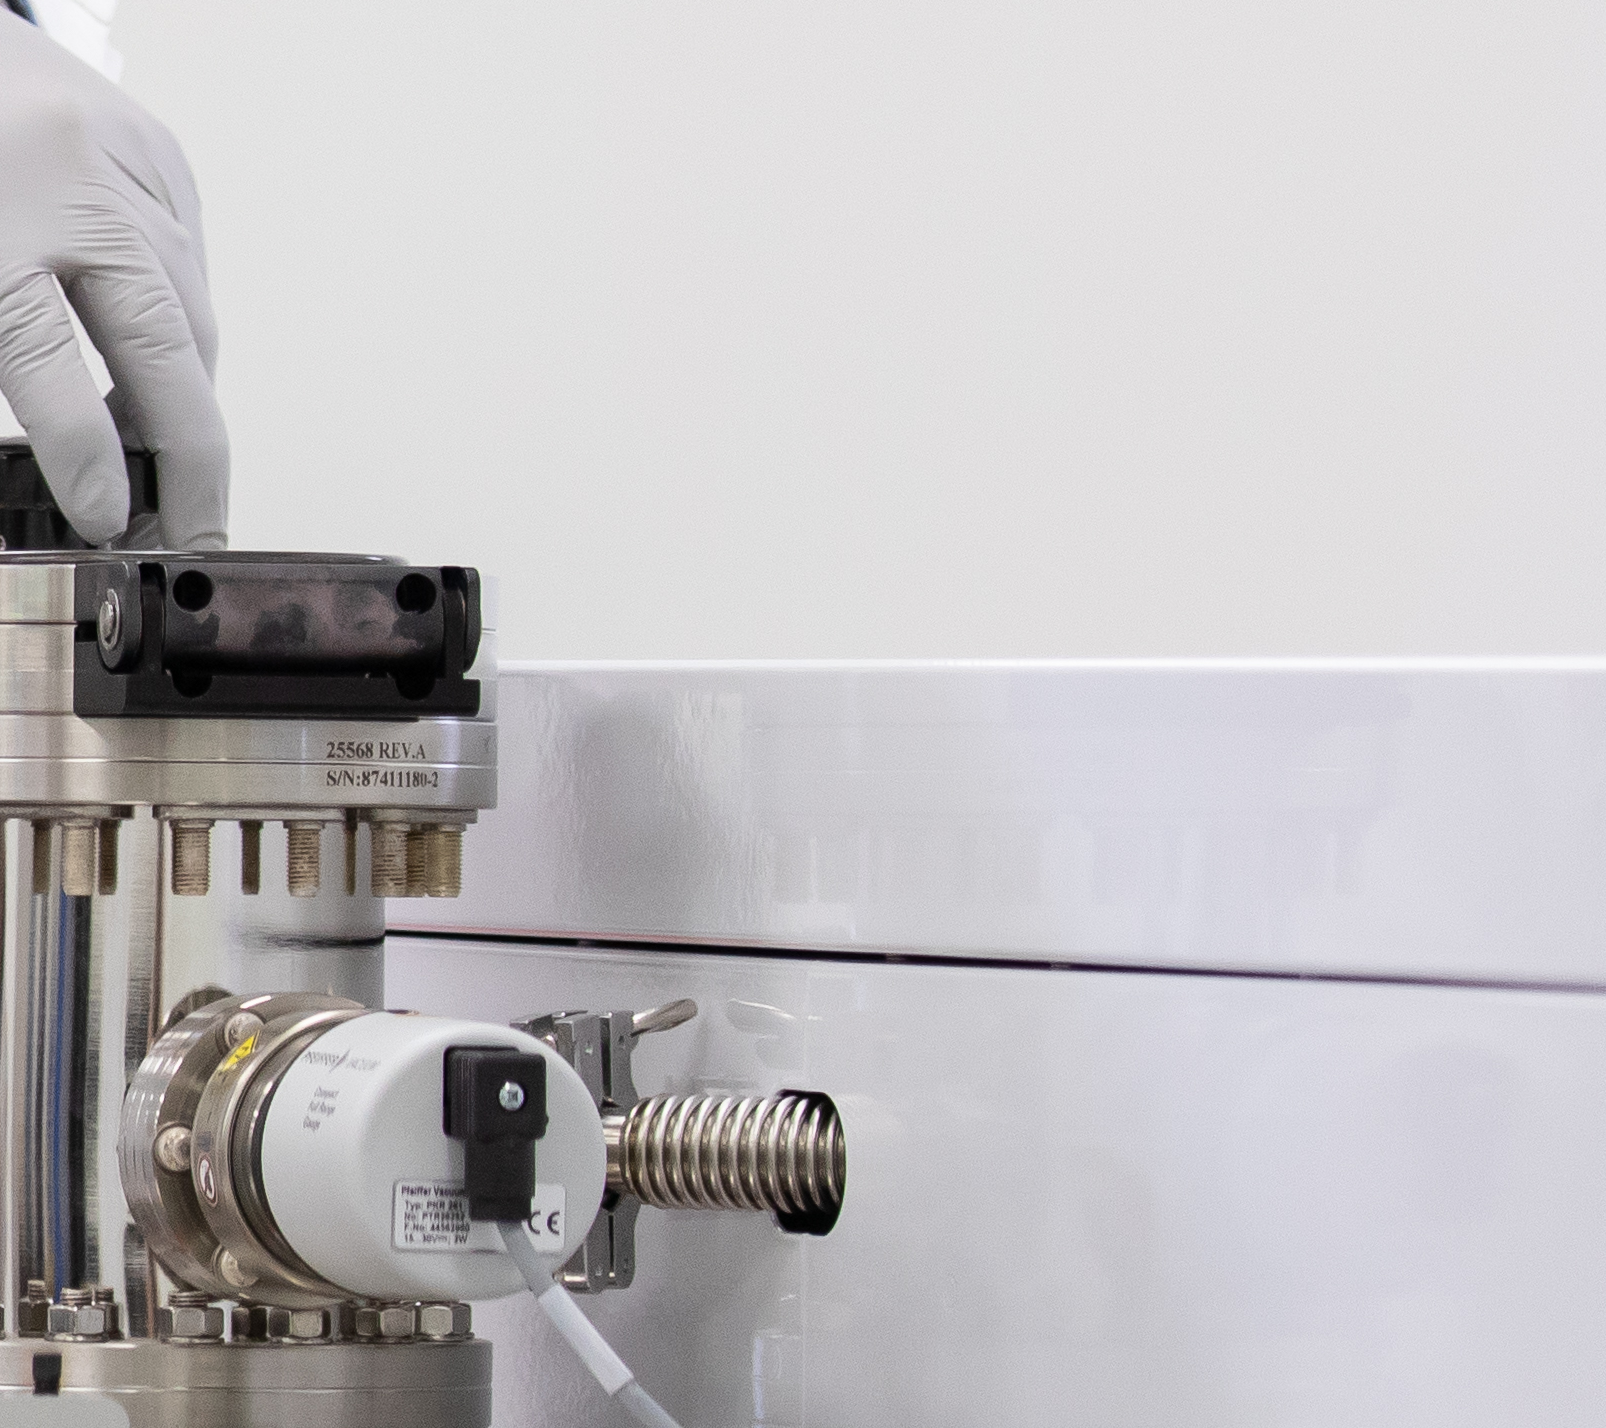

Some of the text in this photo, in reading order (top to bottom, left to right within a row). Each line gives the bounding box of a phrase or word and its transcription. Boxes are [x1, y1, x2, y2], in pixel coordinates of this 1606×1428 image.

[326, 741, 426, 759] 25568 REV.A
[401, 1185, 432, 1196] Pfeiffer
[527, 1210, 561, 1236] CE
